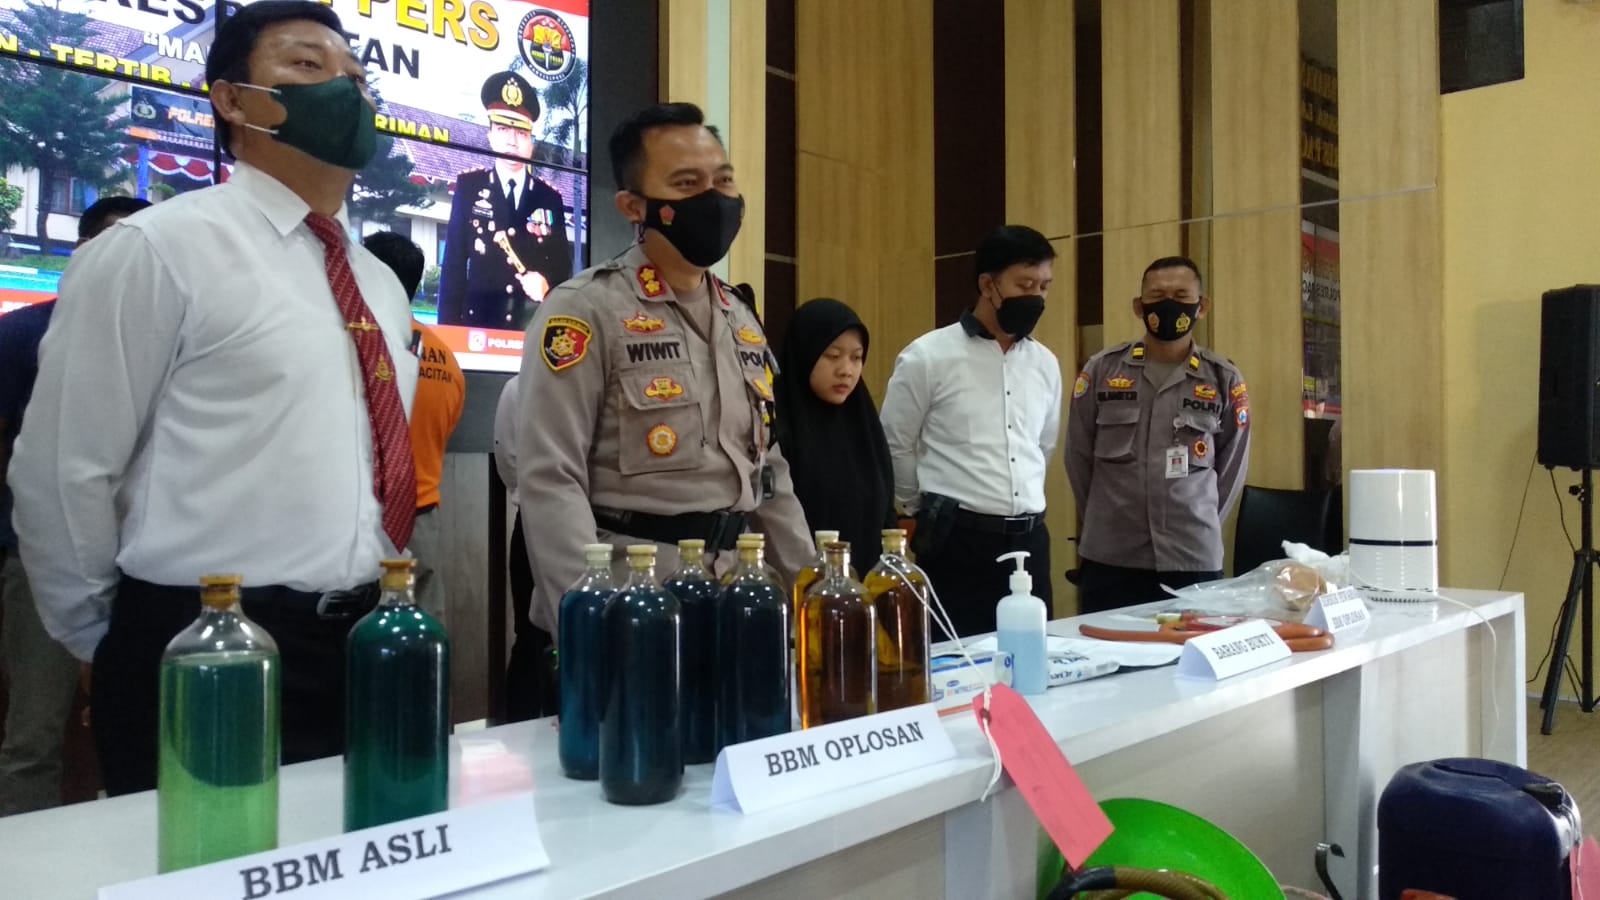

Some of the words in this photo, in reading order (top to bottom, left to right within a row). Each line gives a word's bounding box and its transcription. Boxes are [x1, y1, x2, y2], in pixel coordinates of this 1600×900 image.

[626, 341, 681, 363] WIWIT
[1183, 398, 1220, 414] POLRI
[1211, 640, 1249, 660] BARANG
[1244, 633, 1275, 651] BUKTI
[764, 744, 821, 777] BBM
[824, 721, 925, 761] OPLOSAN
[239, 848, 344, 900] BBM
[359, 824, 453, 873] ASLI
